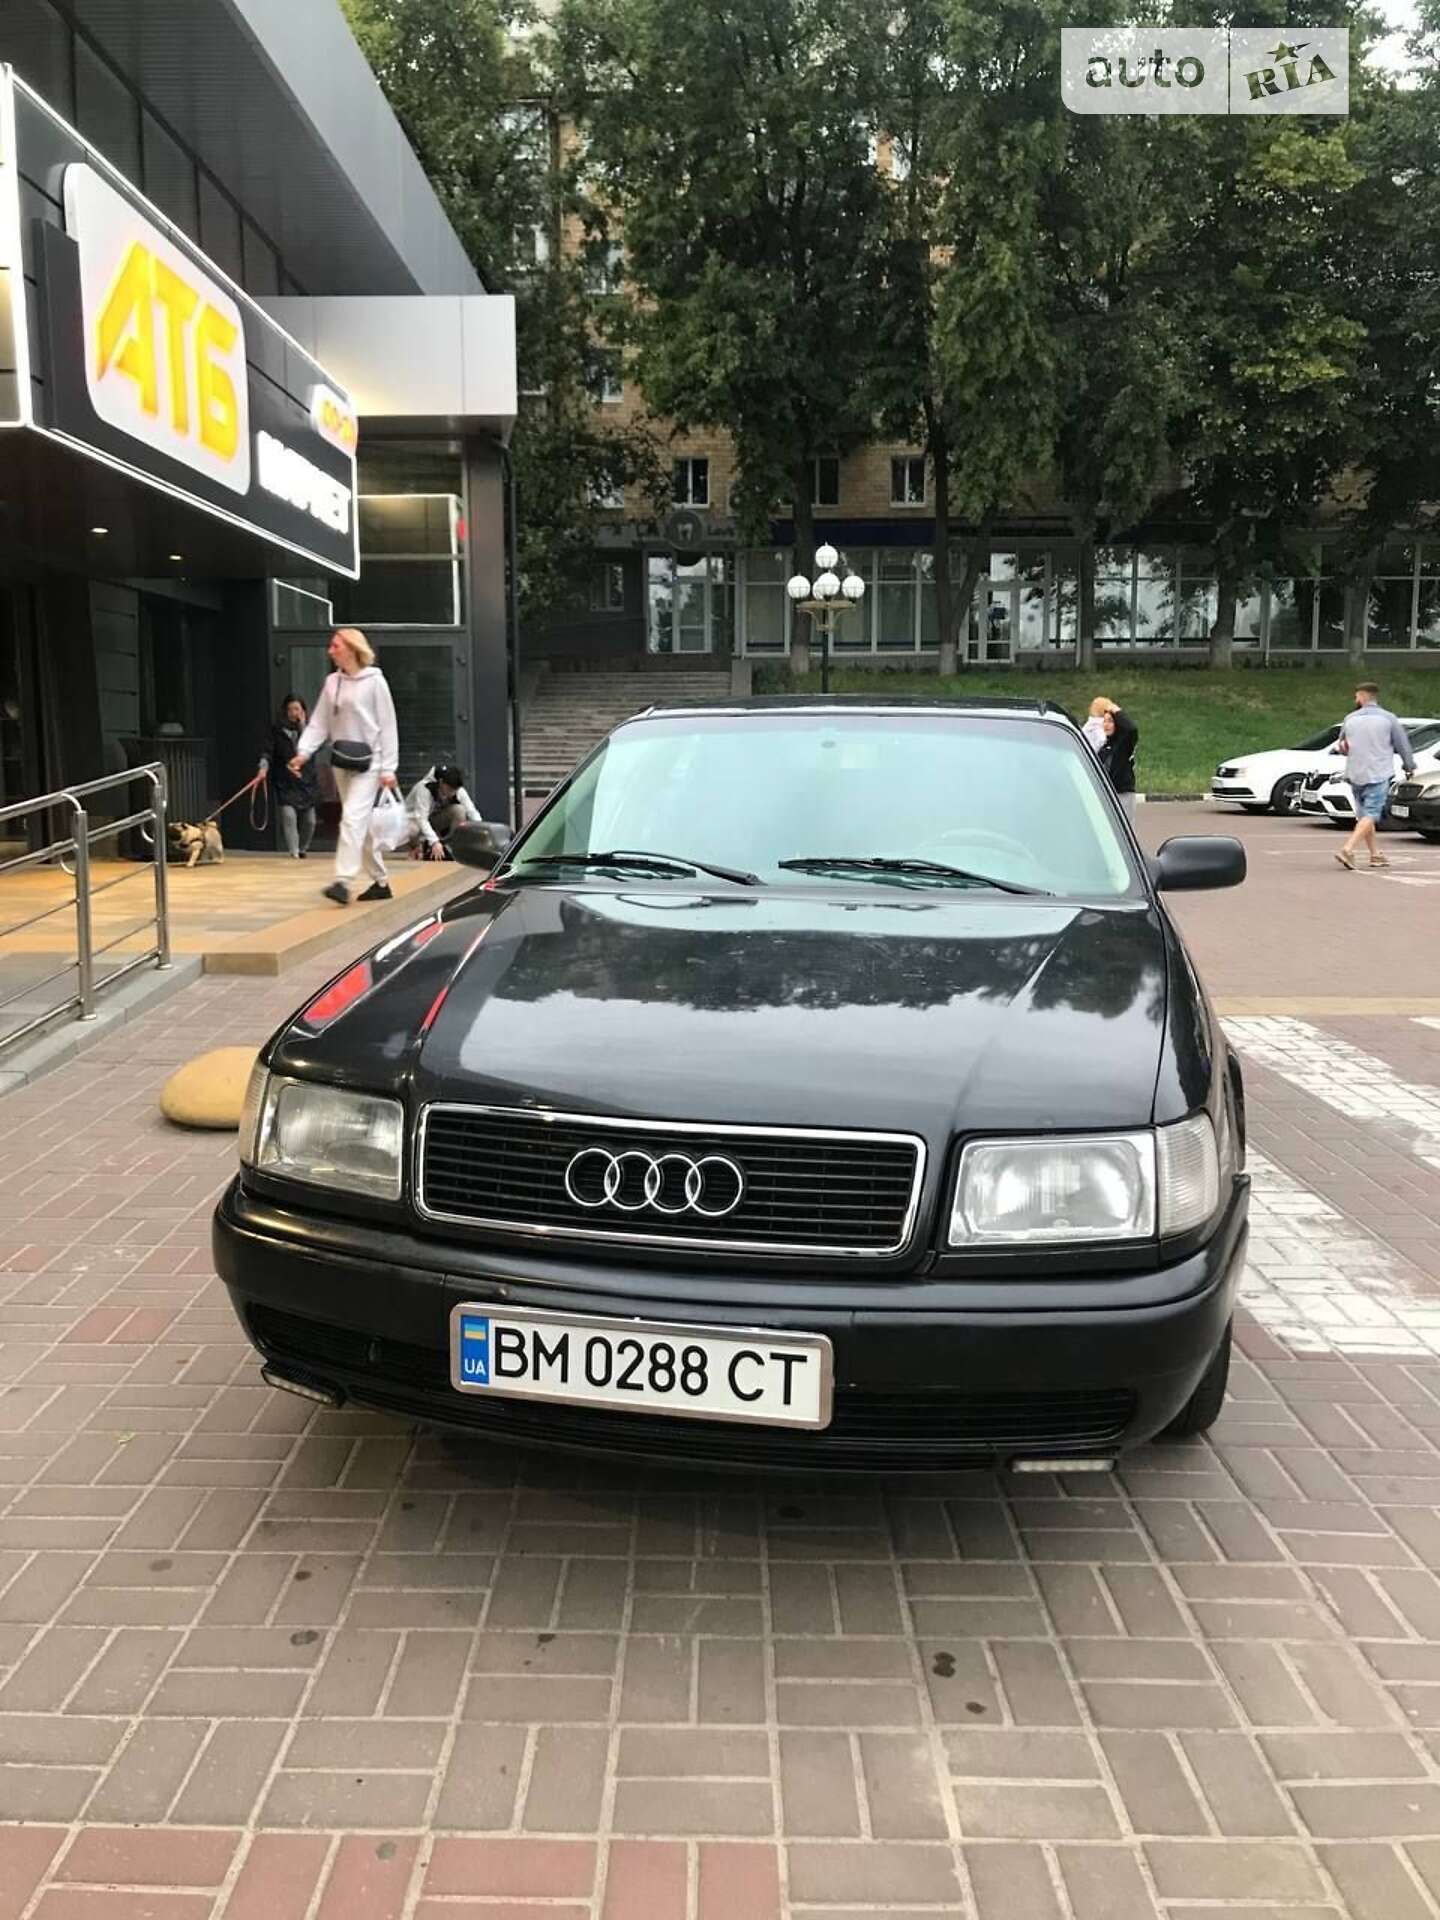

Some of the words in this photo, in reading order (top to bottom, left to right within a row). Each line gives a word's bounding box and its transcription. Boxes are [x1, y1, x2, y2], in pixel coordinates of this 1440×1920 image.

[96, 240, 239, 464] АТБ
[464, 1358, 486, 1376] UA
[495, 1327, 569, 1383] BM
[584, 1336, 708, 1396] 0288
[728, 1350, 808, 1405] CT
